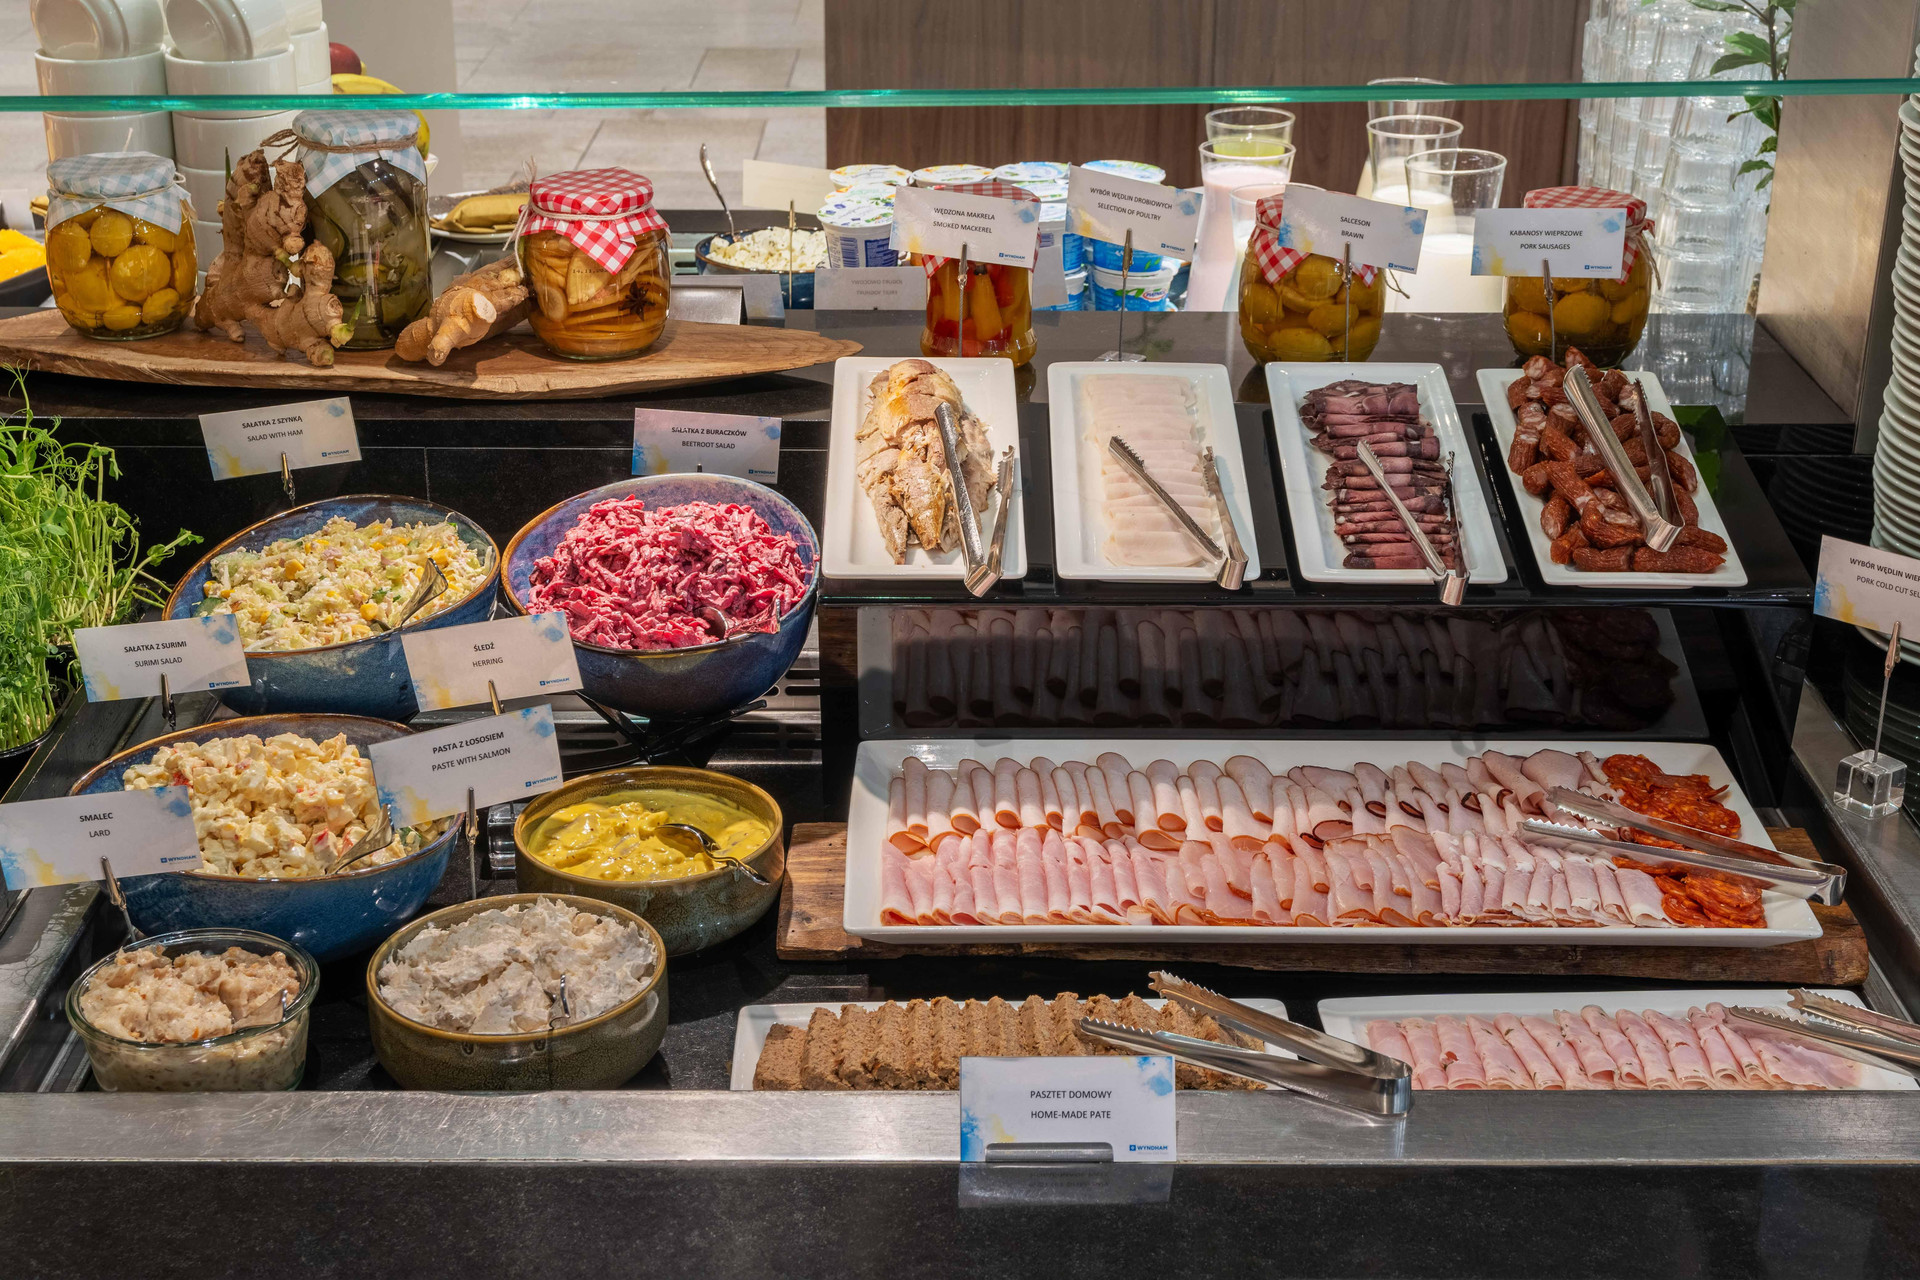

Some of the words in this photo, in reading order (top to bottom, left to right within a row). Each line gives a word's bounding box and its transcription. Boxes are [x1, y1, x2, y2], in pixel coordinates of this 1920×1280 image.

[1090, 187, 1110, 196] WYBÓR
[1112, 192, 1133, 202] WĘDLIN
[1134, 196, 1172, 210] DROBIOWYCH
[934, 207, 965, 216] WĘDZONA
[966, 212, 995, 220] MAKRELA
[1098, 202, 1126, 214] SELECTION
[1136, 210, 1161, 221] POULTRY
[933, 221, 960, 229] SMOKED
[960, 224, 992, 233] MACKEREL
[1340, 216, 1371, 227] SALCESON
[1341, 230, 1364, 240] BRAWN
[242, 419, 271, 429] SAŁATKA
[277, 415, 303, 424] SZYNKĄ
[247, 434, 268, 442] SALAD
[269, 432, 286, 440] WITH
[287, 429, 304, 437] HAM
[706, 428, 748, 437] BURACZKÓW
[1849, 557, 1875, 570] WYBÓR
[1876, 564, 1903, 577] WĘDLIN
[1856, 575, 1874, 585] PORK
[1875, 580, 1893, 590] COLD
[1895, 585, 1908, 594] CUT
[124, 644, 155, 653] SAŁATKA
[161, 640, 187, 649] SURIMI
[473, 642, 495, 652] ŚLEDŹ
[135, 659, 160, 668] SURIMI
[160, 656, 183, 665] SALAD
[472, 656, 504, 667] HERRING
[432, 742, 458, 754] PASTA
[464, 731, 505, 747] ŁOSOSIEM
[432, 759, 455, 772] PASTE
[456, 754, 477, 766] WITH
[478, 747, 511, 762] SALMON
[532, 775, 558, 786] WYNDHAM
[79, 812, 114, 822] SMALEC
[89, 829, 111, 838] LARD
[168, 855, 197, 863] WYNDHAM
[1030, 1090, 1067, 1099] PASZTET
[1069, 1090, 1112, 1099] DOMOWY
[1031, 1110, 1088, 1119] HOME-MADE
[1090, 1110, 1111, 1119] PATE
